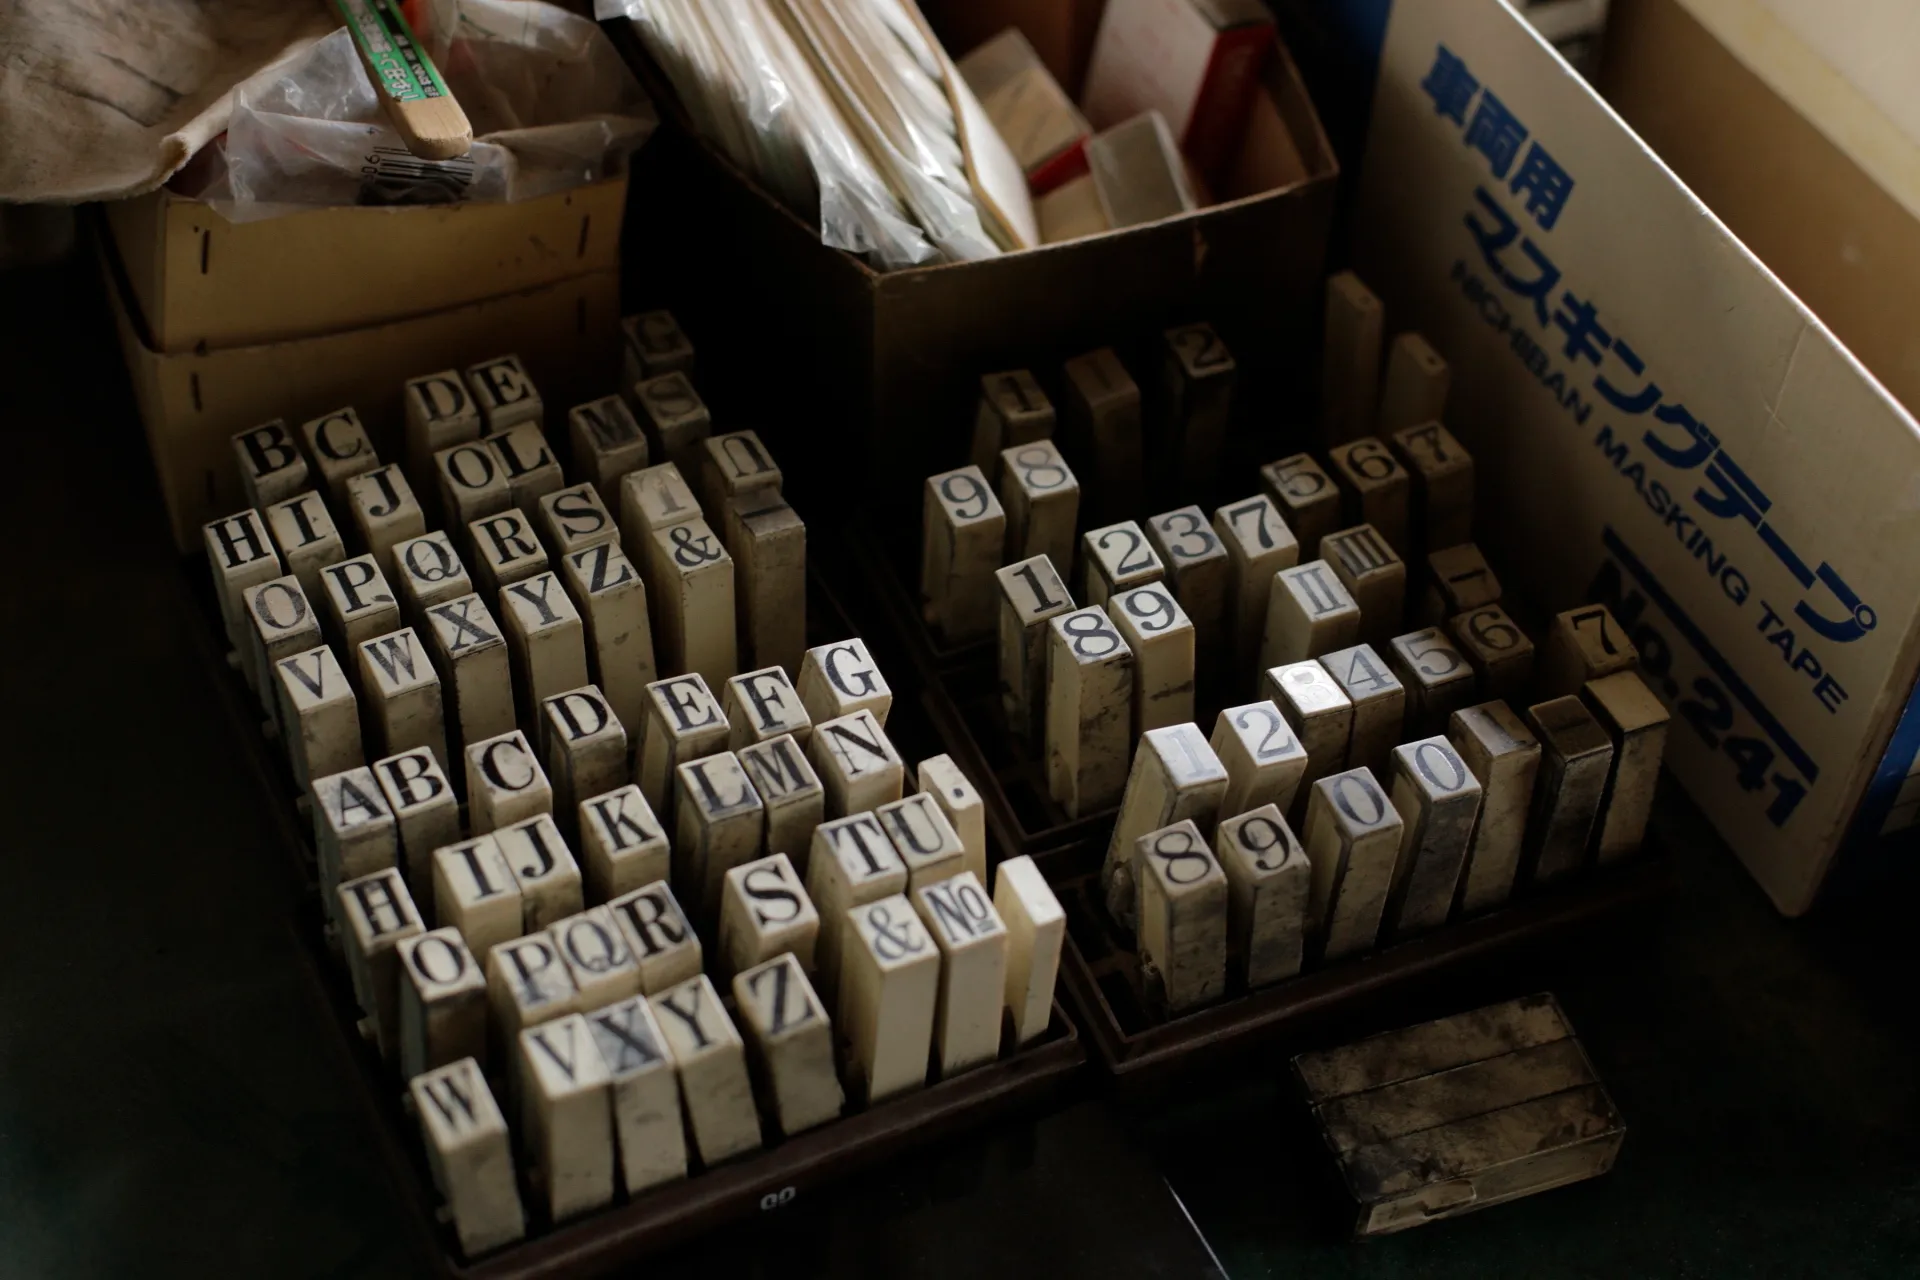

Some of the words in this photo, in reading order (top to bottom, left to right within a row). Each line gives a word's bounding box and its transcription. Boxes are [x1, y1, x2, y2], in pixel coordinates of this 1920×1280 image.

[1421, 42, 1575, 231] 車両用
[412, 378, 467, 422] D
[473, 359, 530, 409] E
[314, 412, 364, 461] C
[1464, 186, 1878, 642] マスキングテープ
[237, 424, 298, 479] B
[447, 446, 495, 490] O
[488, 430, 551, 480] L
[1016, 445, 1067, 489] 8
[1275, 458, 1324, 498] 5
[1347, 443, 1396, 481] 6
[360, 472, 401, 517] J
[940, 473, 990, 520] 9
[1449, 258, 1592, 427] NICHIBAN
[1595, 428, 1751, 607] MASKING
[1757, 598, 1850, 715] TAPE
[209, 512, 270, 569] H
[477, 516, 538, 565] R
[554, 490, 607, 538] S
[1162, 513, 1216, 558] 3
[1230, 502, 1277, 549] 7
[404, 539, 463, 583] Q
[572, 543, 630, 593] Z
[674, 526, 722, 567] &
[1099, 529, 1159, 576] 2
[253, 583, 307, 630] O
[329, 561, 376, 615] P
[510, 575, 563, 626] Y
[1012, 563, 1063, 614] 1
[1125, 589, 1177, 631] 9
[429, 598, 498, 652] X
[1062, 612, 1121, 656] 8
[1469, 611, 1520, 651] 6
[1571, 609, 1620, 659] 7
[283, 651, 325, 701] V
[364, 632, 419, 686] W
[824, 645, 880, 699] G
[1345, 649, 1391, 692] 4
[1412, 634, 1461, 677] 5
[548, 691, 609, 741] D
[658, 677, 722, 732] E
[734, 669, 791, 729] F
[822, 716, 890, 775] N
[1171, 728, 1218, 778] 1
[1236, 707, 1294, 760] 2
[379, 752, 444, 807] B
[484, 736, 536, 791] C
[685, 758, 753, 815] L
[744, 739, 813, 800] M
[336, 775, 389, 829] A
[591, 794, 658, 854] K
[882, 797, 945, 856] U
[510, 821, 556, 879] J
[829, 819, 889, 878] T
[1153, 830, 1211, 886] 8
[1238, 816, 1292, 871] 9
[346, 879, 415, 940] H
[746, 862, 802, 926] S
[562, 919, 629, 971] Q
[615, 896, 689, 959] R
[866, 905, 923, 962] &
[411, 935, 468, 985] O
[499, 946, 556, 1005] P
[654, 984, 716, 1049] Y
[748, 961, 816, 1034] Z
[533, 1023, 587, 1084] V
[588, 1002, 662, 1076] X
[422, 1064, 485, 1129] W
